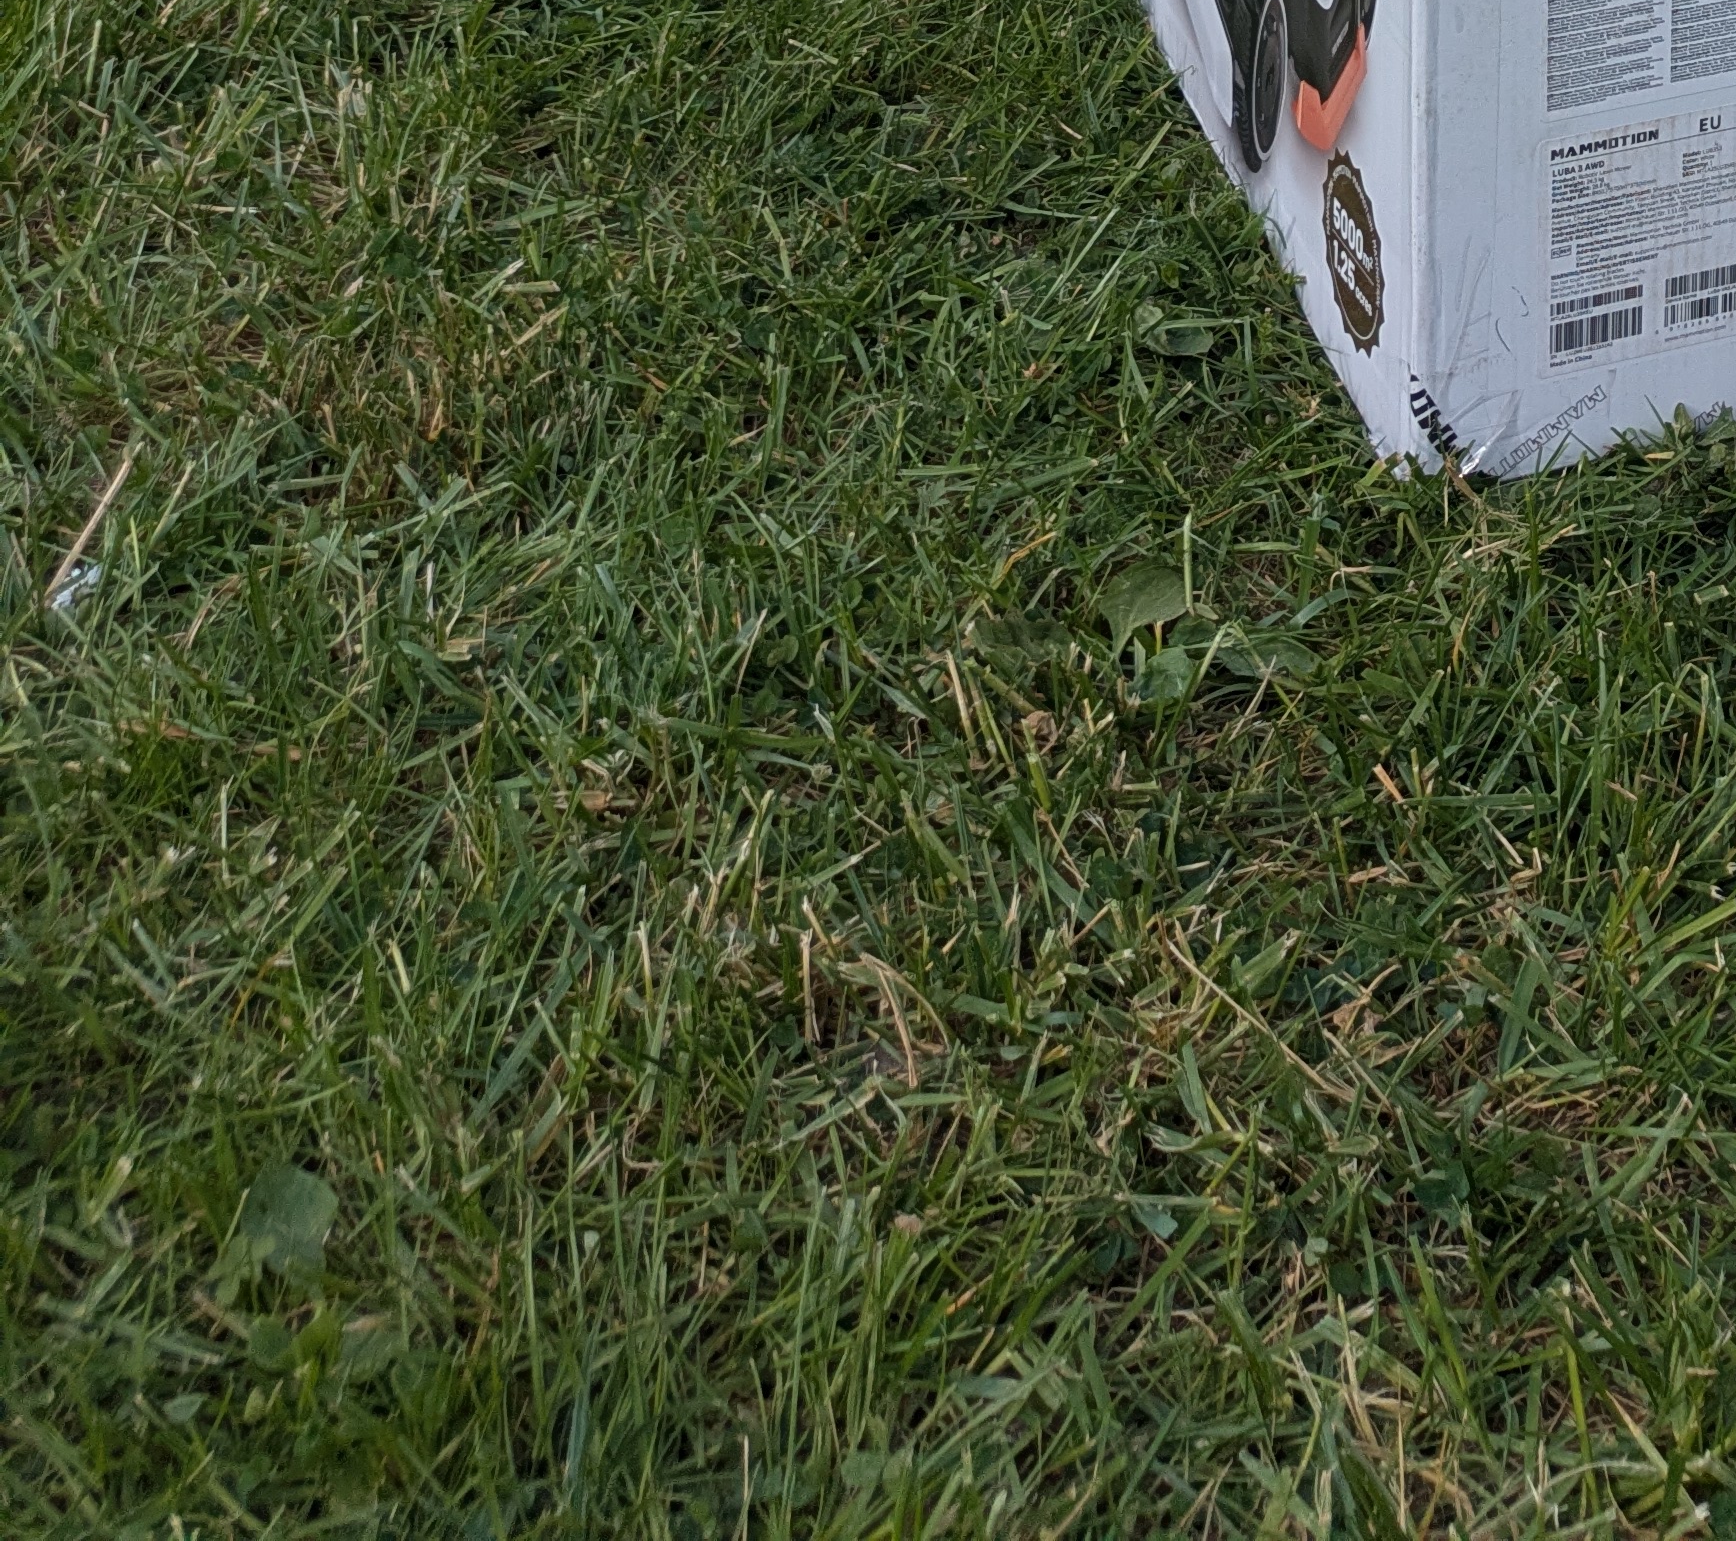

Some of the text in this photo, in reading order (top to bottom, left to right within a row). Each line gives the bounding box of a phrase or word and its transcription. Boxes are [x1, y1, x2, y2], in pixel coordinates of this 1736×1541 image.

[1699, 115, 1722, 132] EU
[1550, 129, 1659, 162] MAMMOTION
[1552, 165, 1575, 177] LUBA
[1584, 159, 1604, 171] AWD
[1333, 240, 1355, 291] 1.25
